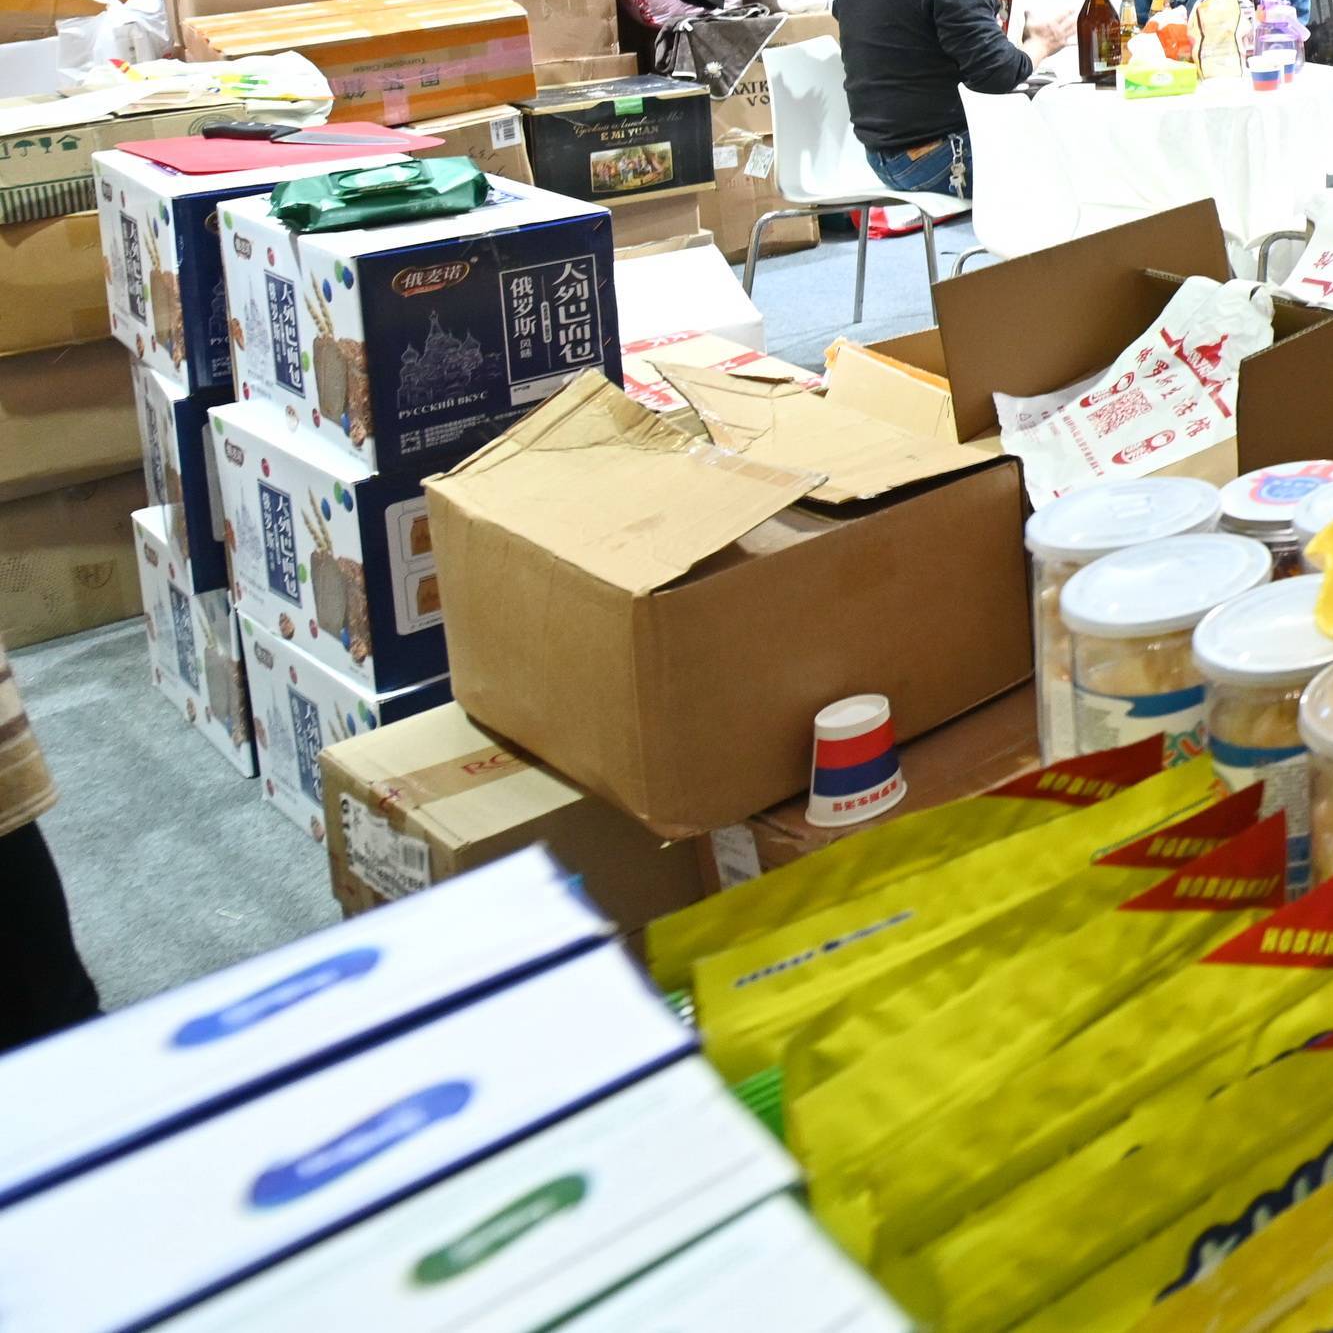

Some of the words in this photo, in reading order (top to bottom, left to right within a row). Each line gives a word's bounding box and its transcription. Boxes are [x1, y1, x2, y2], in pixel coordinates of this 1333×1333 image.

[552, 262, 596, 364] 大列巴面包
